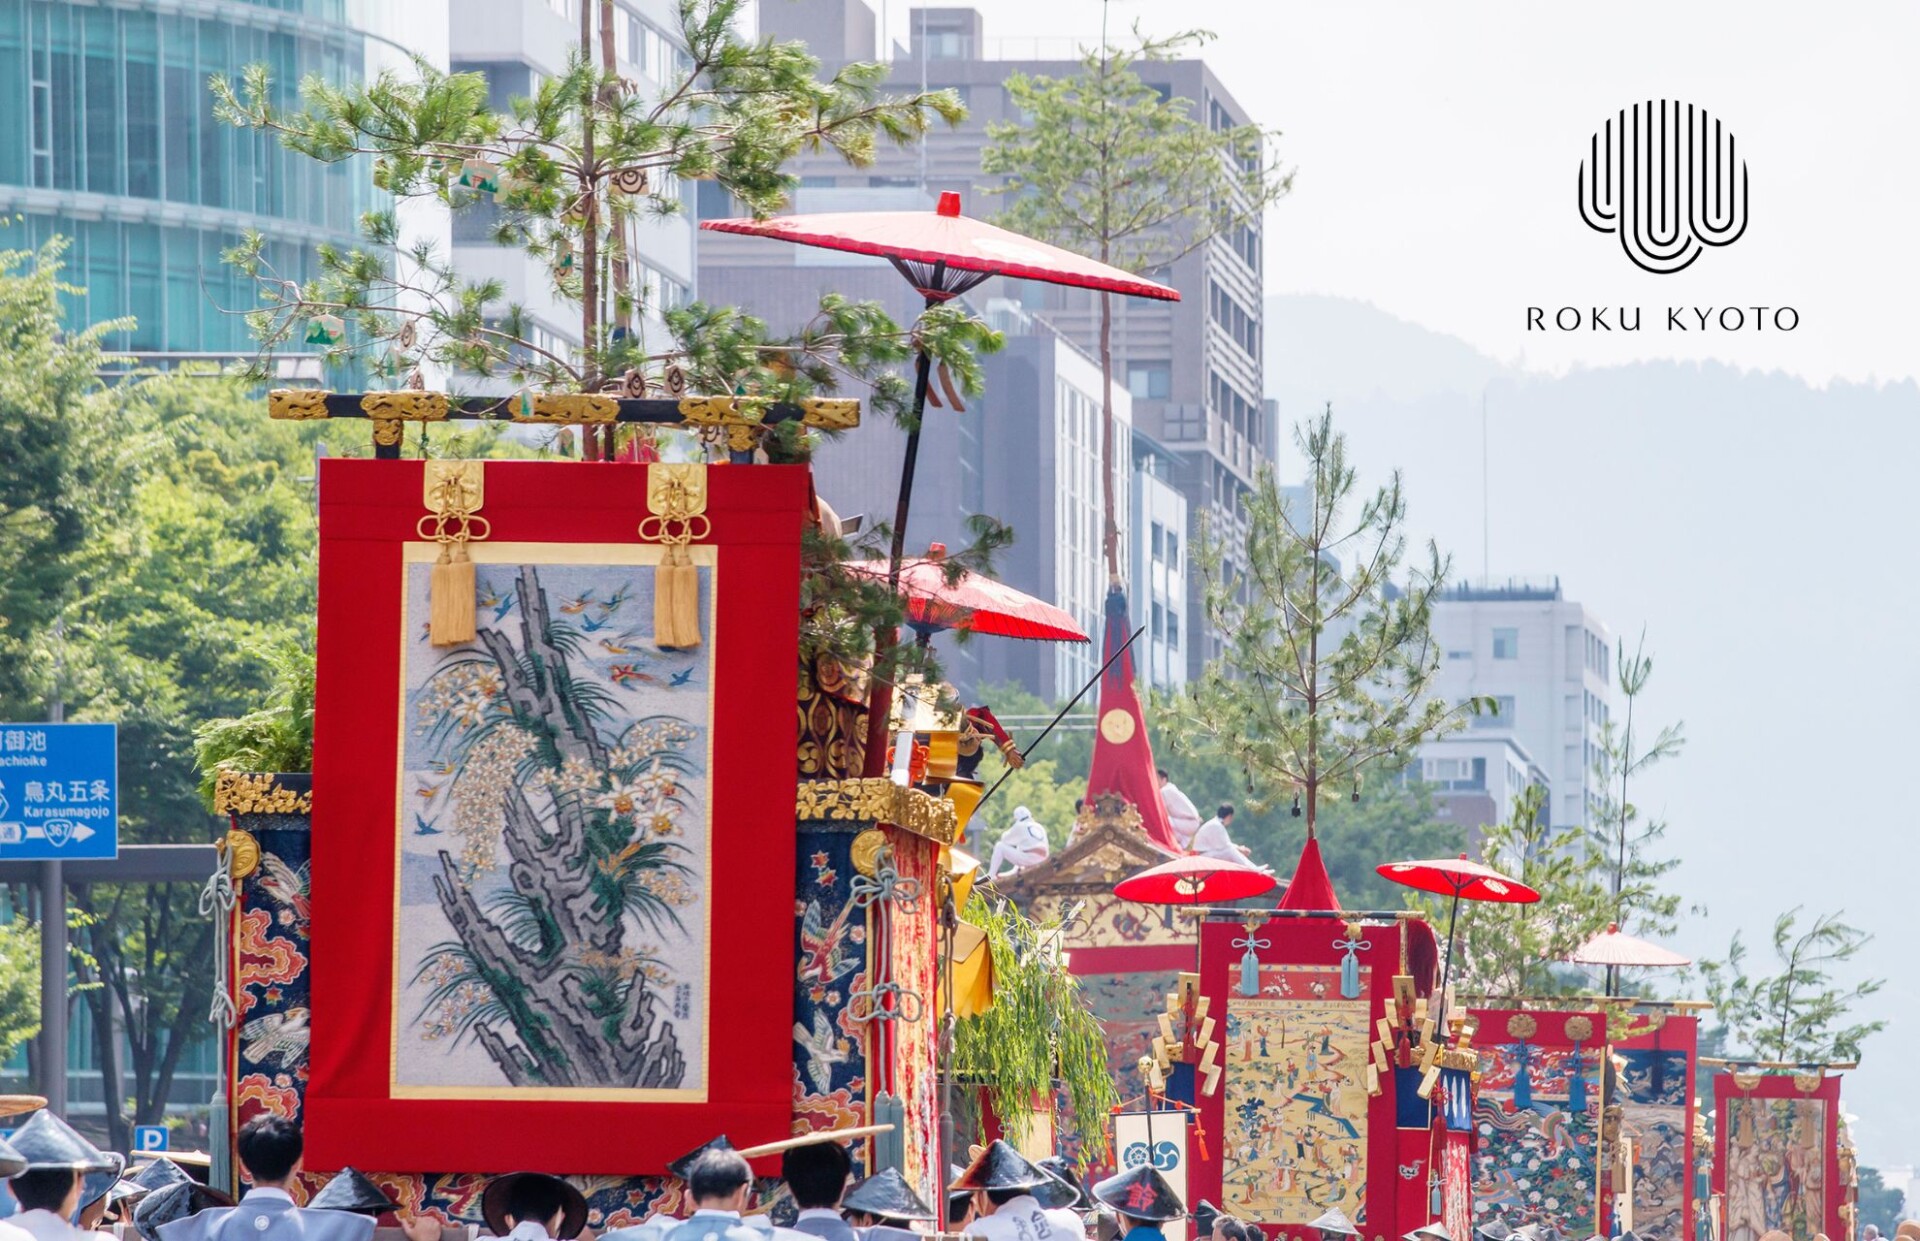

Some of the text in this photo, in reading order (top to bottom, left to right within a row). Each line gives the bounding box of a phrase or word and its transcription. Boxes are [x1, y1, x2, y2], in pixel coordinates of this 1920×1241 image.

[0, 730, 47, 751] 御池
[24, 780, 110, 802] 烏丸五条
[24, 805, 110, 819] Karasumagojo
[48, 823, 69, 837] 367
[143, 1129, 163, 1151] P
